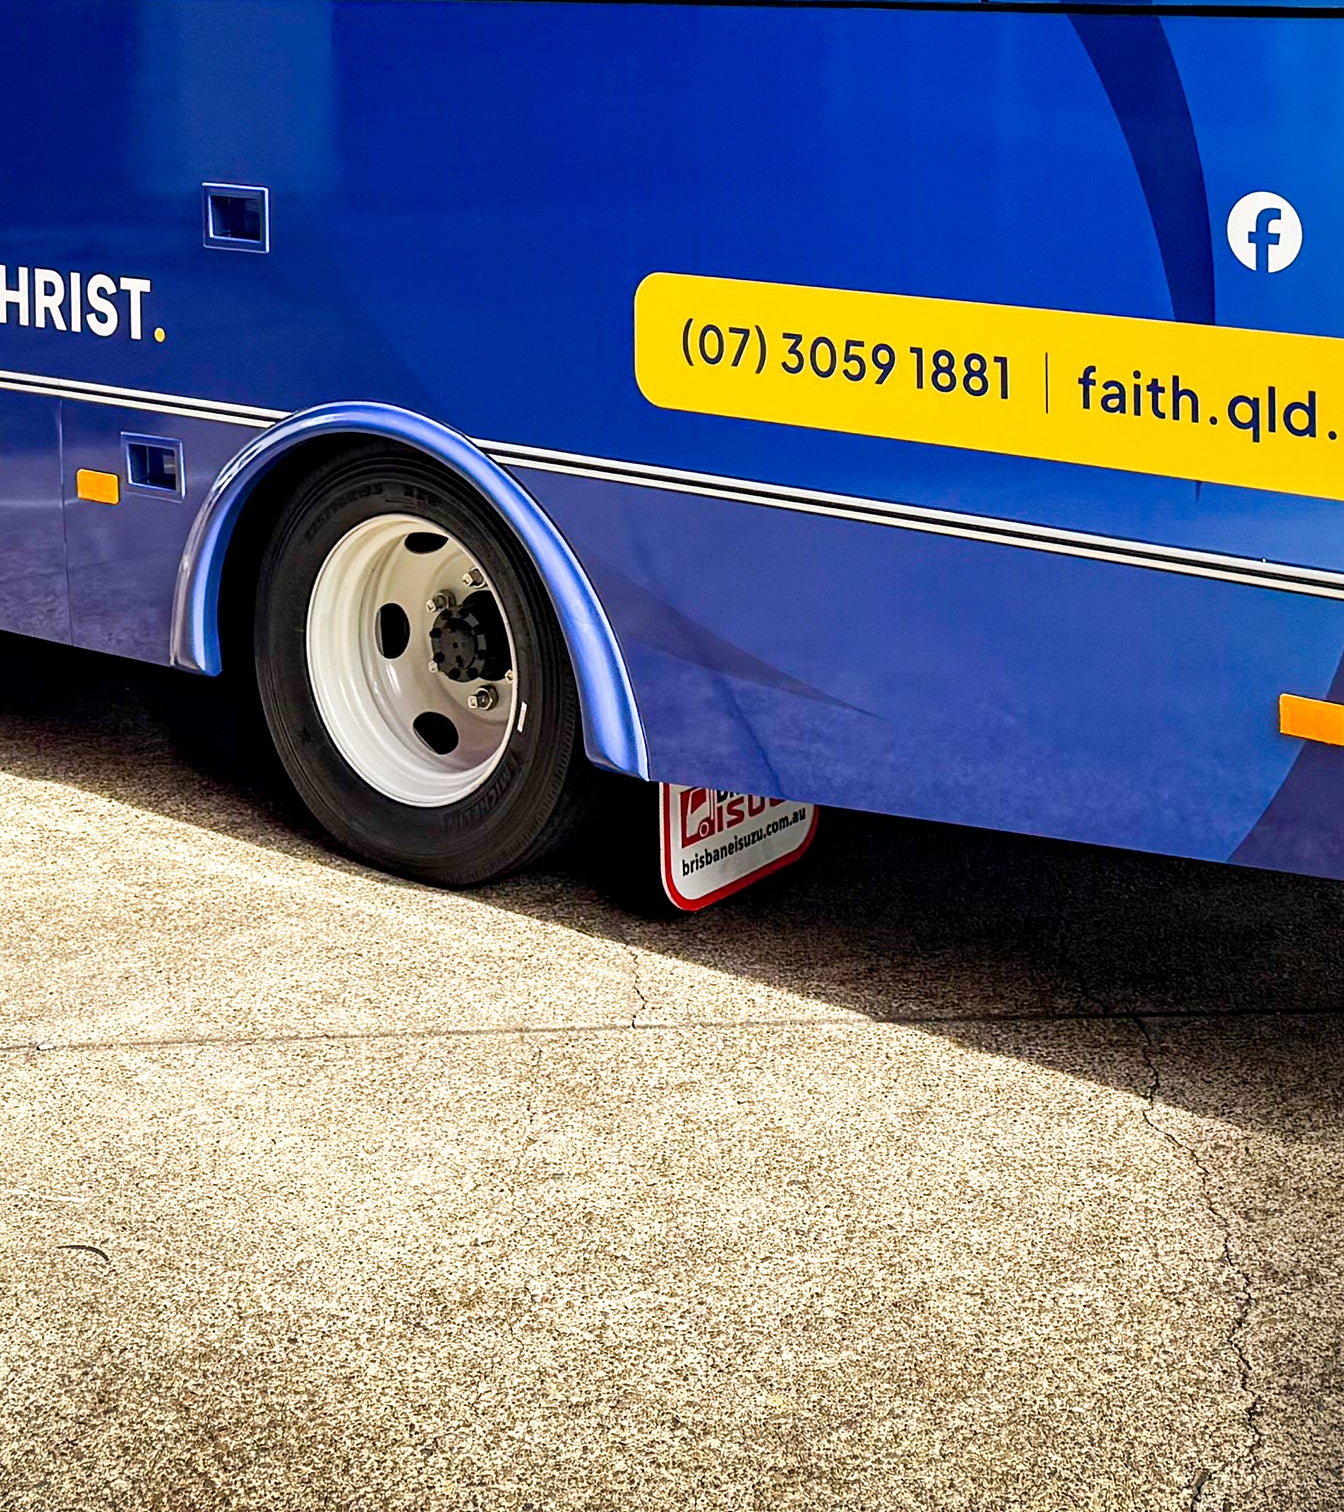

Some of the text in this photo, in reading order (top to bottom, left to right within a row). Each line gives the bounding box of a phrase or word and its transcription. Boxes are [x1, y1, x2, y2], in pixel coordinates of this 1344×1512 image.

[682, 318, 767, 374] (07)
[781, 332, 896, 385] 3059
[909, 346, 1009, 400] 1881
[682, 807, 806, 877] brisbaneisuzu.com.au
[717, 791, 785, 833] ISU
